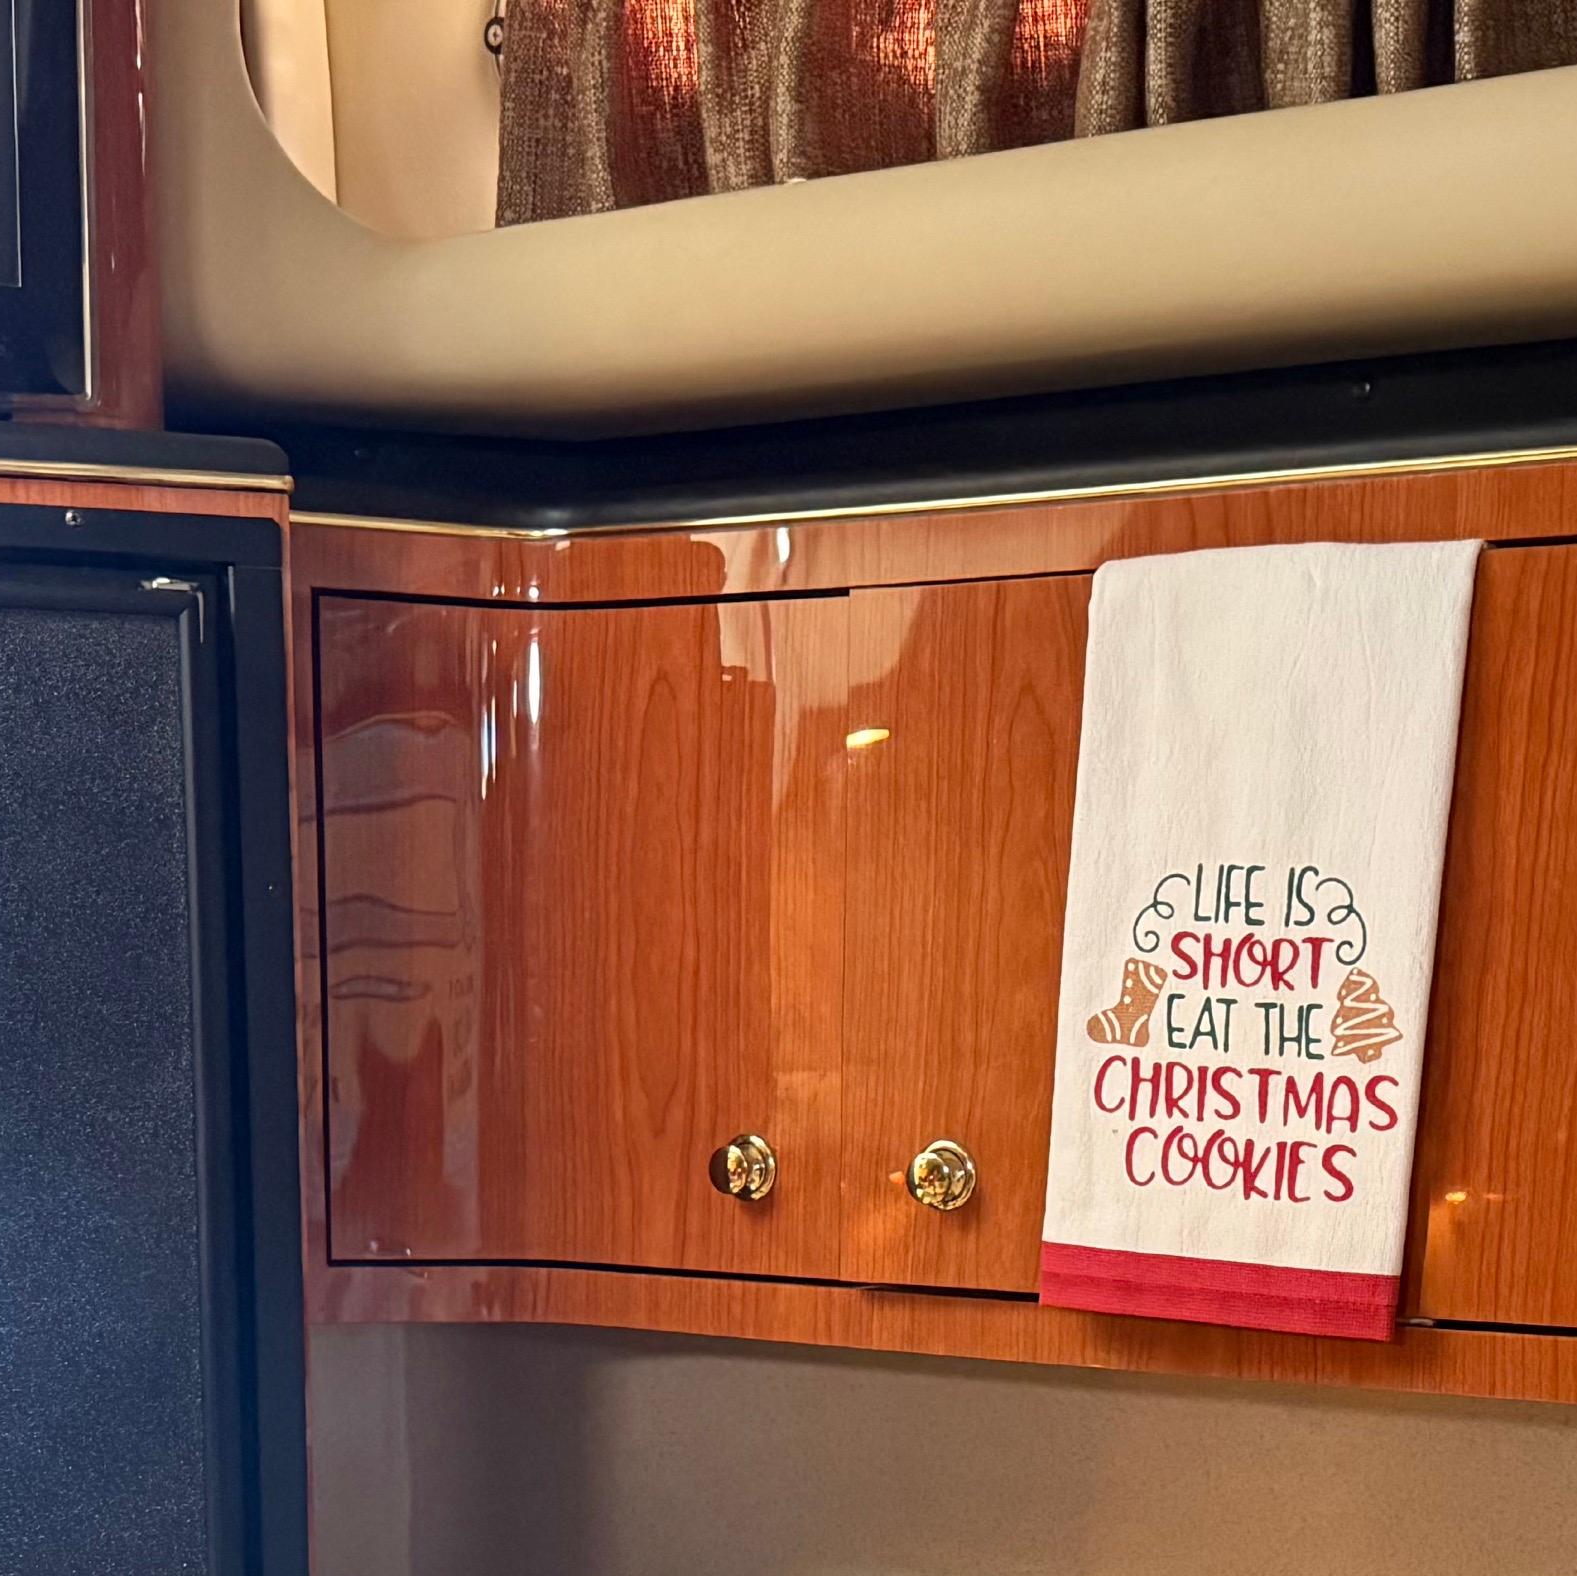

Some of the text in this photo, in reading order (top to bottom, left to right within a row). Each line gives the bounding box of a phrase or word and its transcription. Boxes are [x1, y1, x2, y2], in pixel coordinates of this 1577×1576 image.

[1193, 862, 1320, 928] LIFE IS
[1170, 930, 1335, 992] SHORT
[1166, 993, 1325, 1061] EAT THE
[1093, 1055, 1400, 1135] CHRISTMAS
[1124, 1125, 1358, 1203] COOKIES
